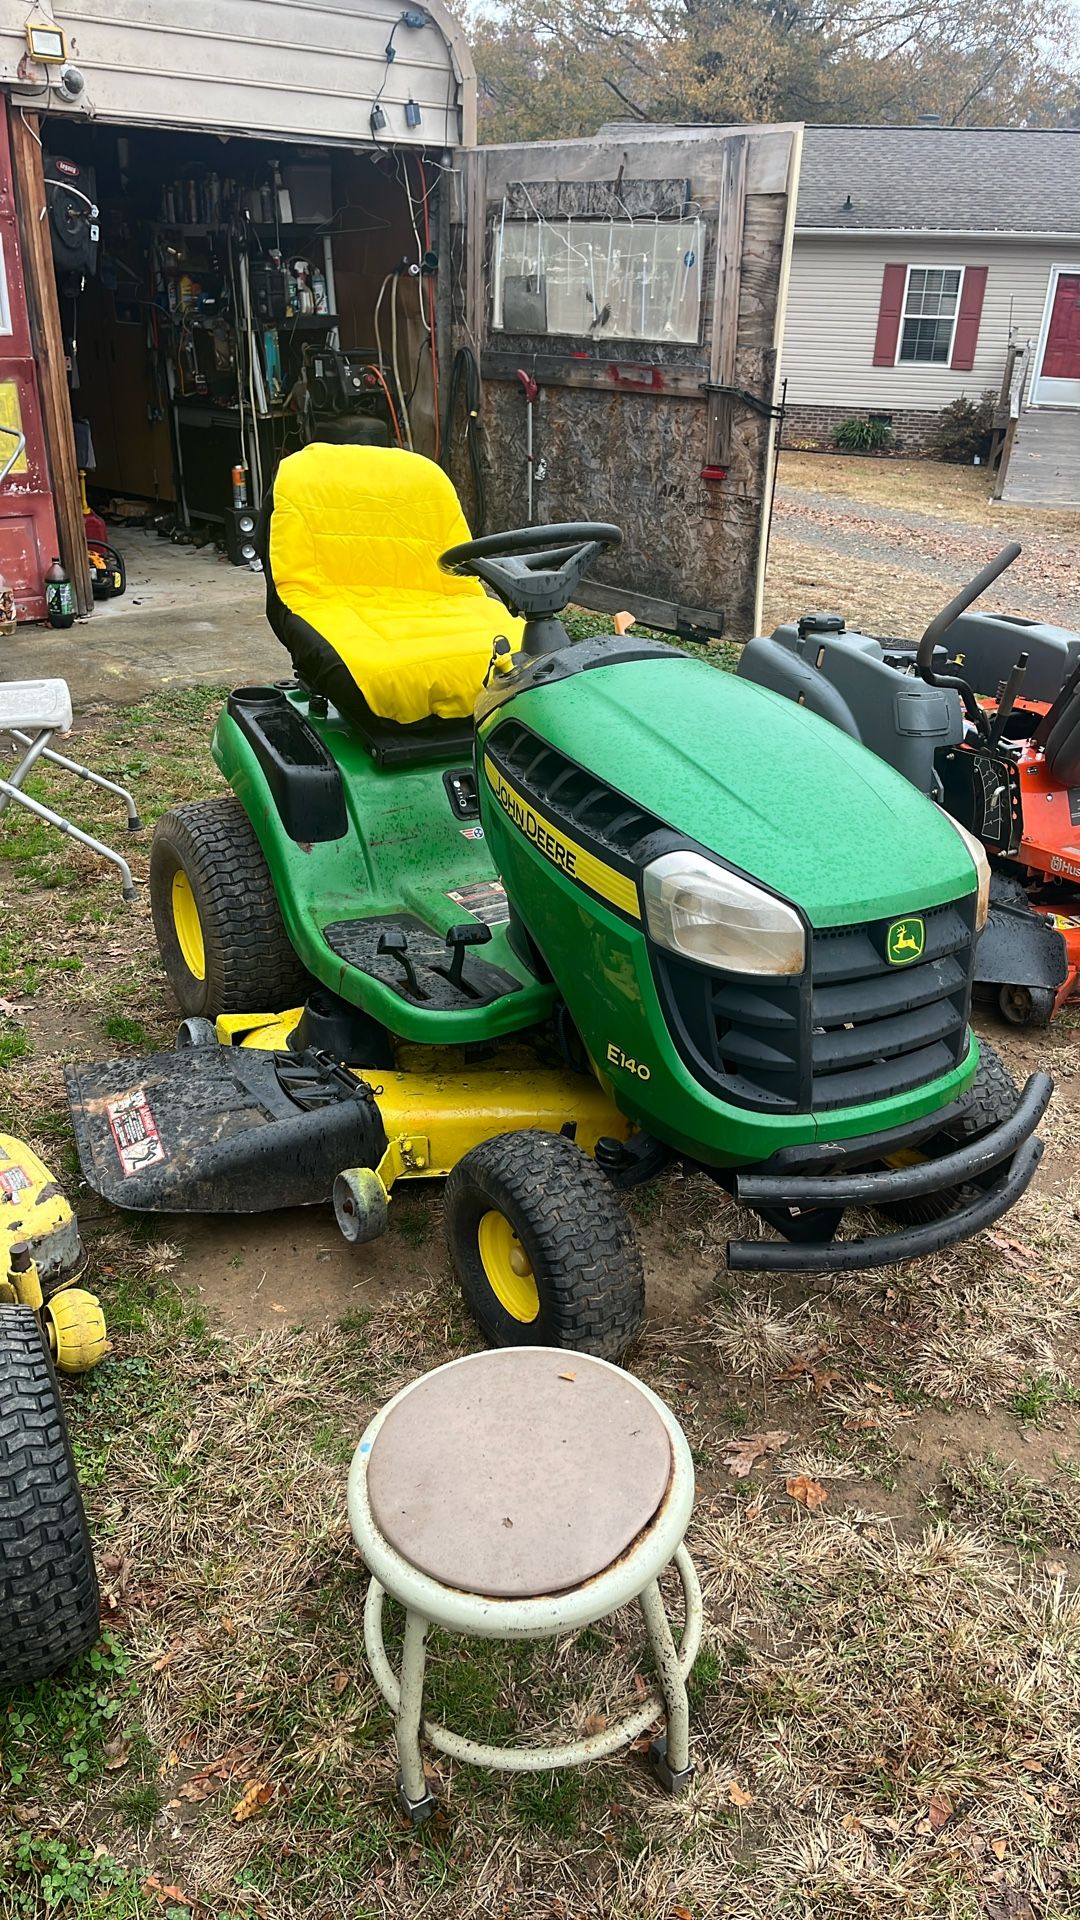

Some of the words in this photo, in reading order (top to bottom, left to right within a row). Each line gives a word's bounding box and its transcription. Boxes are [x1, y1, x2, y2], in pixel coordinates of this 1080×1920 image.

[495, 776, 525, 828] JOHN
[526, 810, 578, 876] DEERE
[607, 1042, 651, 1080] E140
